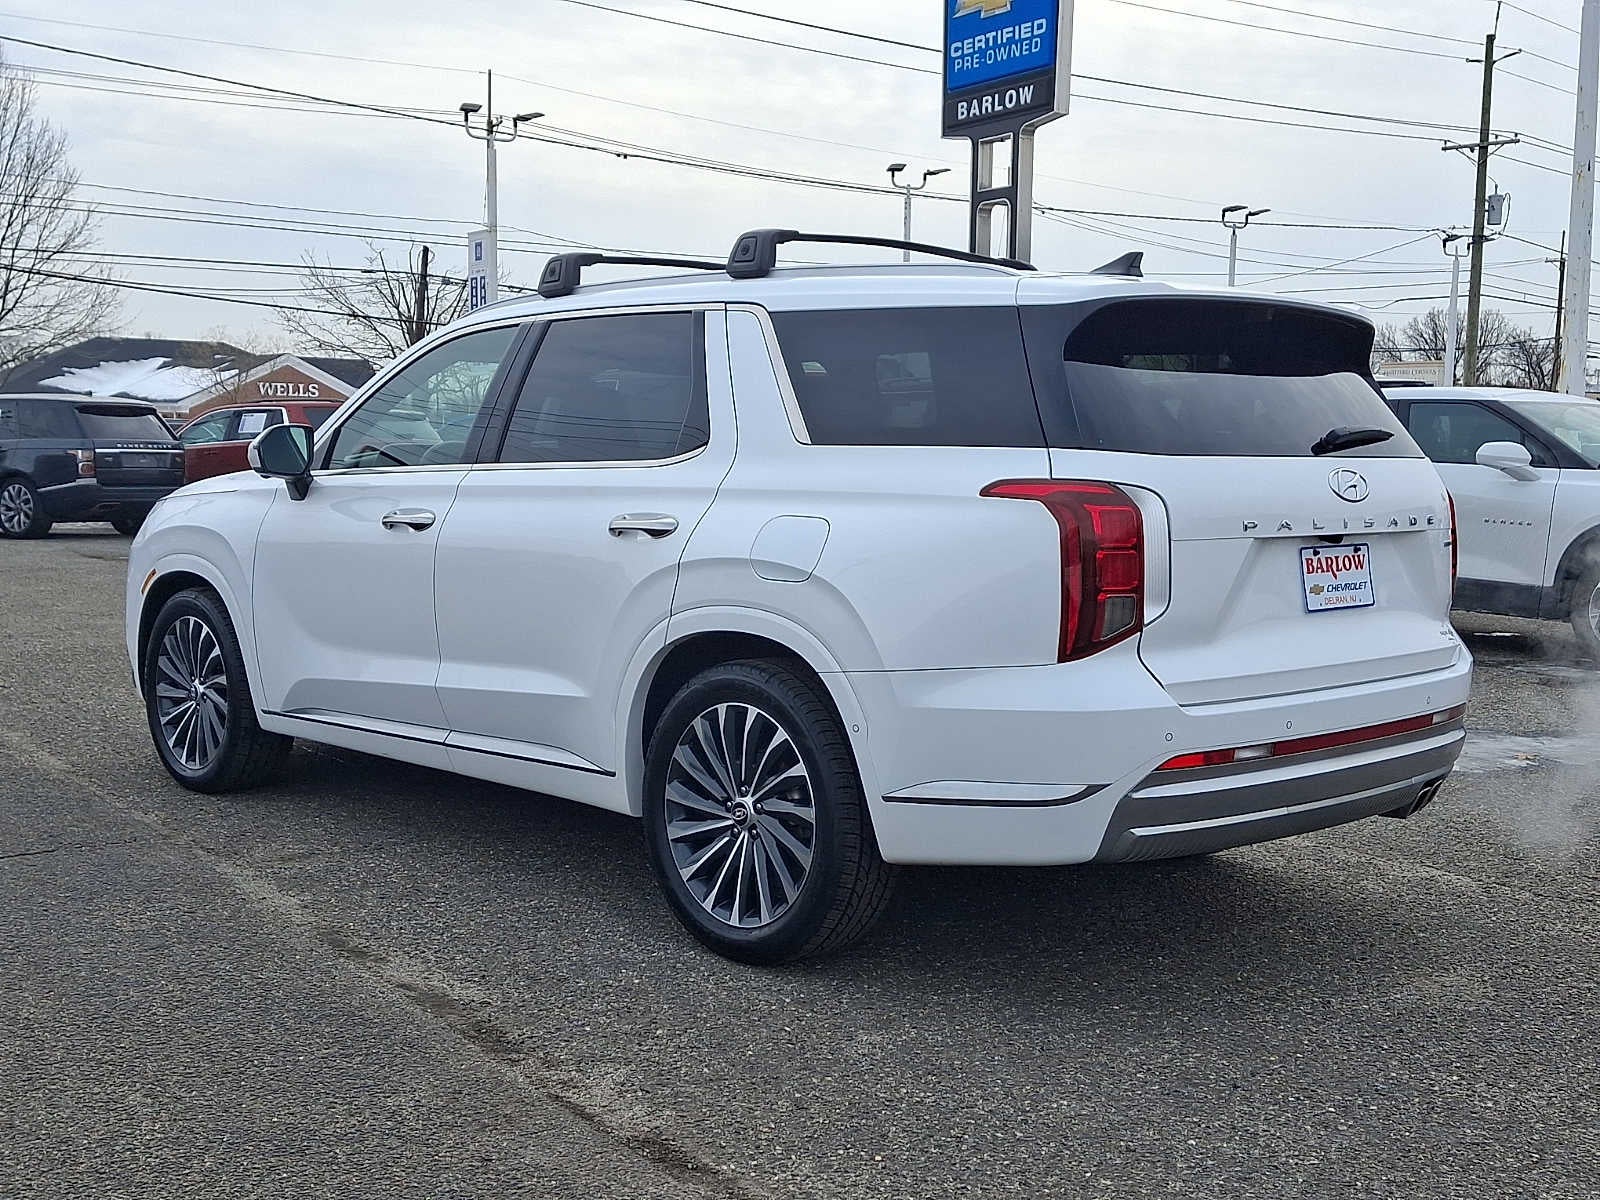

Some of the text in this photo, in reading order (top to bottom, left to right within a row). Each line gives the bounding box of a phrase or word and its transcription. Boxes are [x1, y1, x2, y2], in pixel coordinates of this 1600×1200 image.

[950, 18, 1047, 58] CERTIFIED
[954, 37, 1041, 73] PRE-OWNED
[957, 84, 1035, 120] BARLOW
[257, 381, 319, 397] WELLS
[1242, 515, 1435, 532] PALISADE
[1304, 553, 1365, 580] BARLOW
[1326, 581, 1367, 593] CHEVROLET
